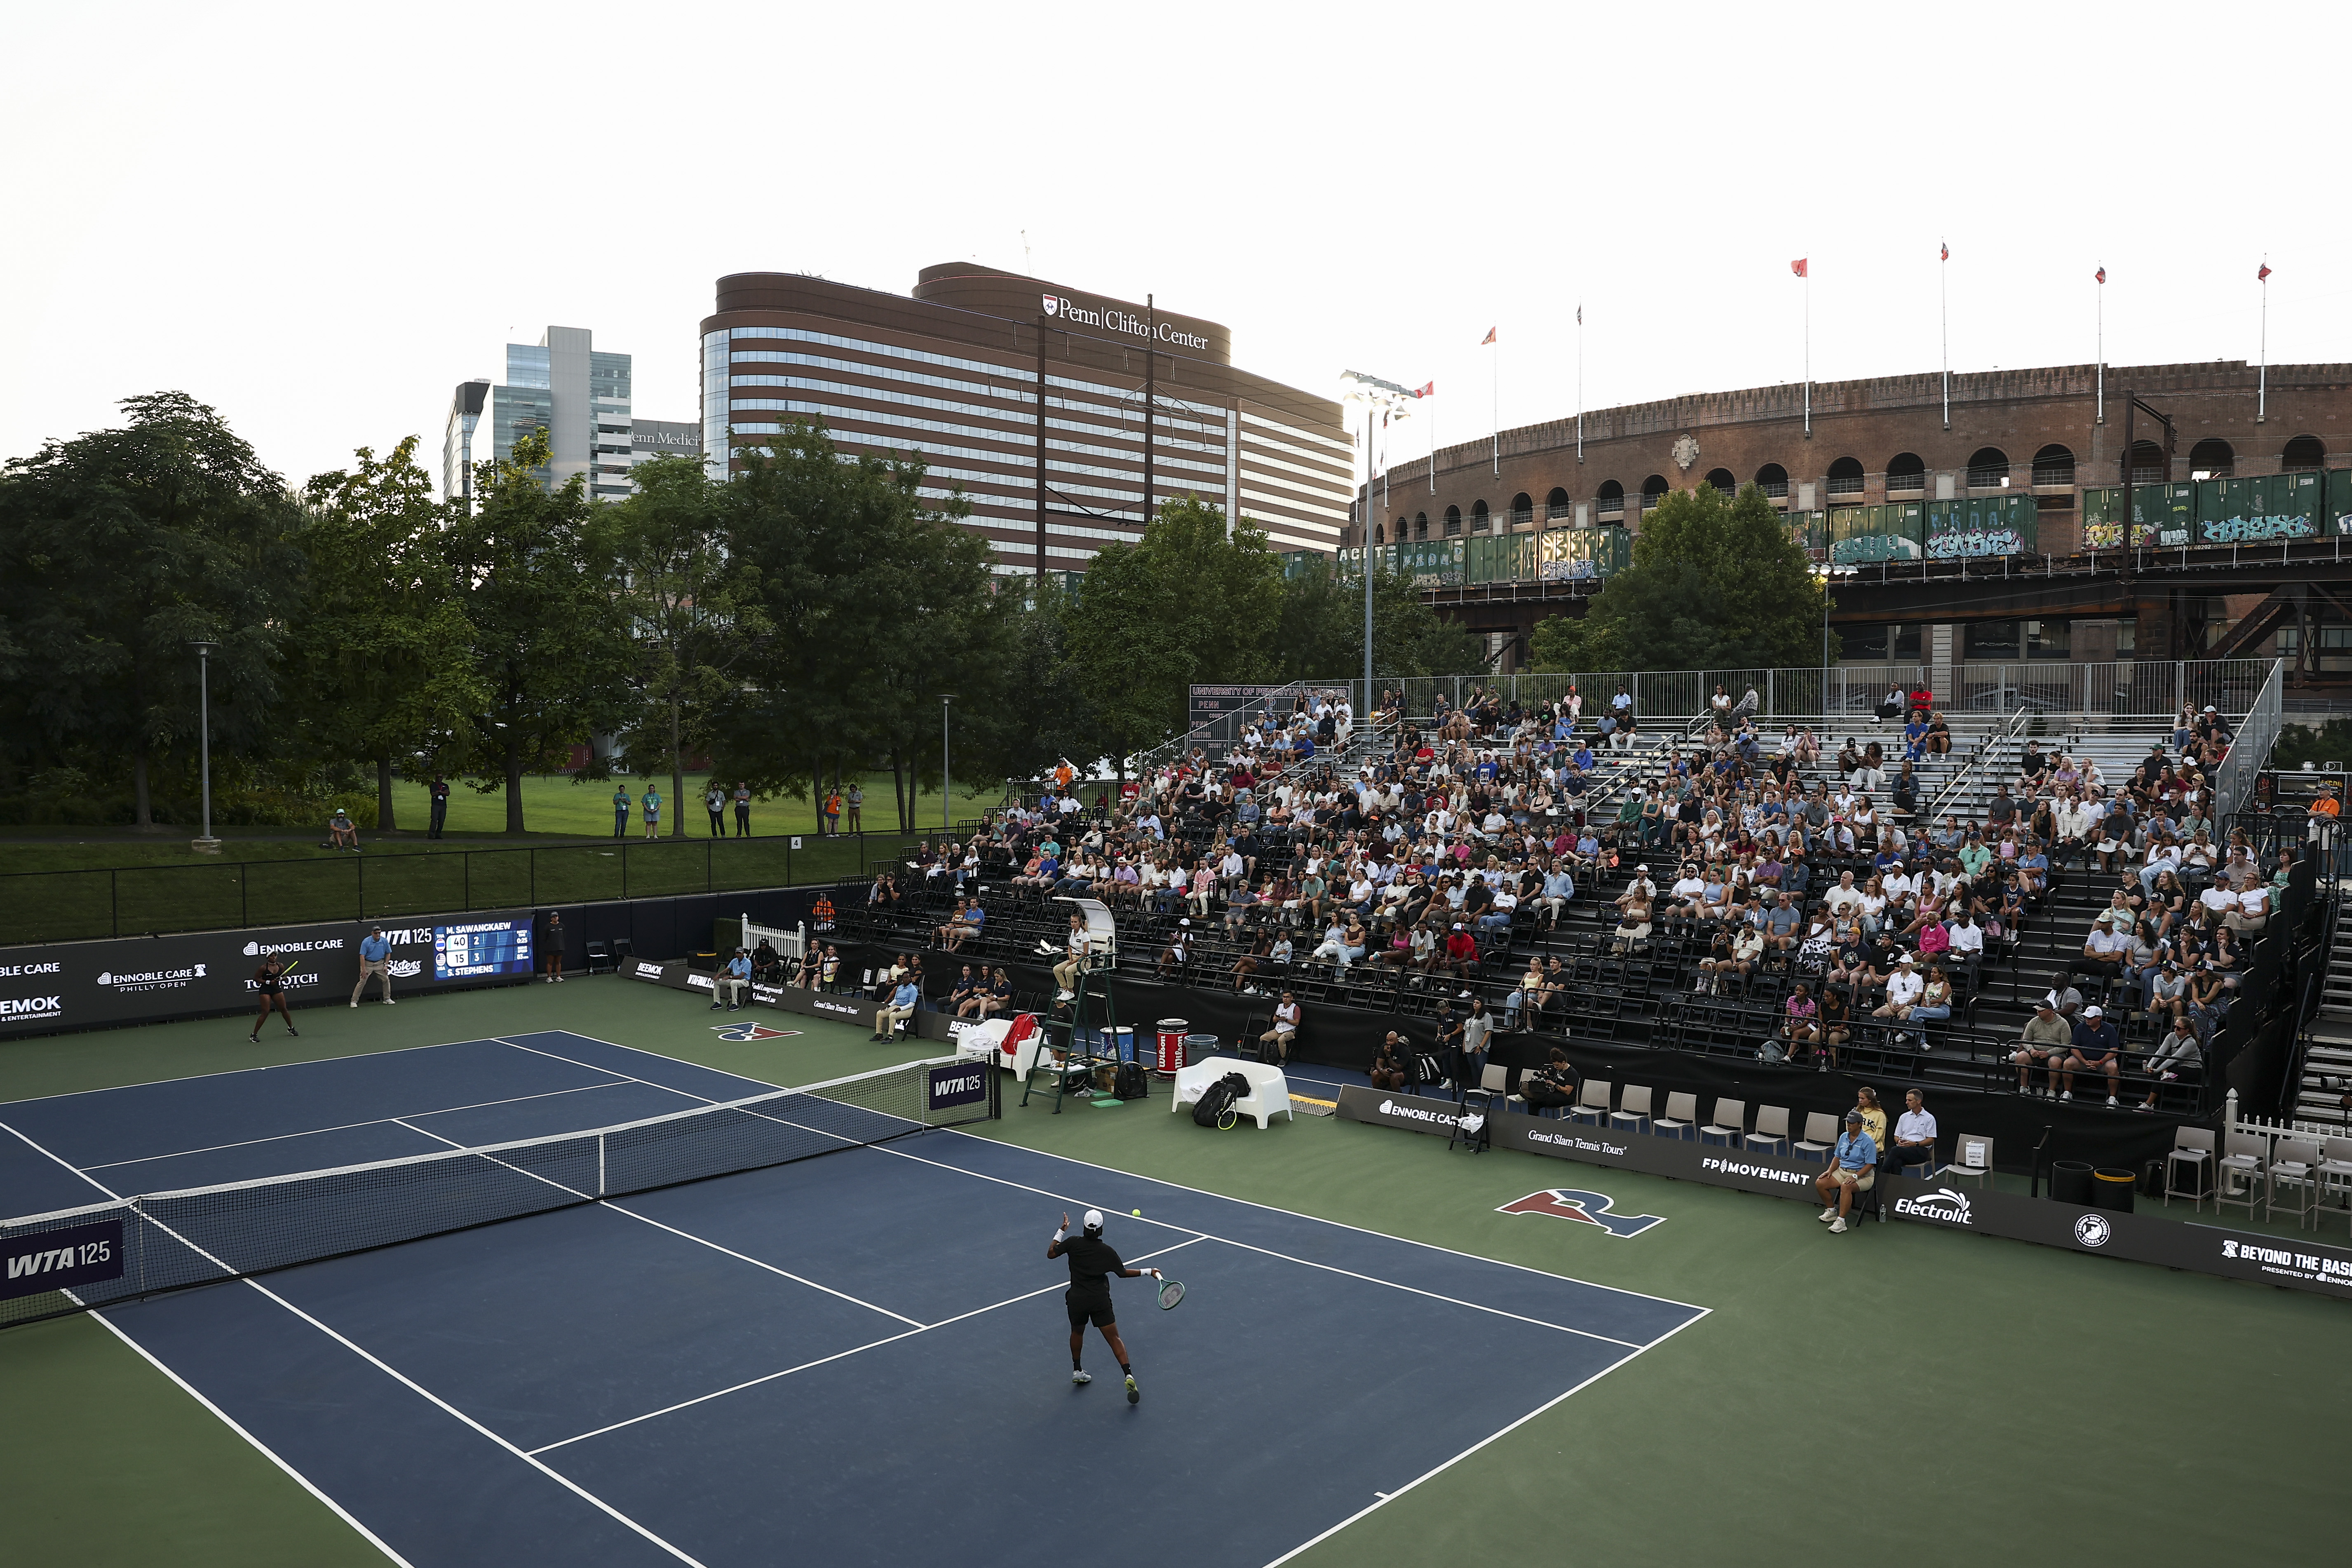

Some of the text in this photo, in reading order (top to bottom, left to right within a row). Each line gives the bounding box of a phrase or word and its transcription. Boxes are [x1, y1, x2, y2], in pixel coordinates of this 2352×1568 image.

[1058, 297, 1100, 326] Penn
[1159, 323, 1209, 350] Center
[657, 432, 701, 446] Medici
[412, 927, 432, 943] 125
[455, 922, 511, 934] SAWANGKAEW
[260, 939, 343, 955] ENNOBLE CARE
[454, 937, 465, 946] 40
[474, 936, 479, 945] 2
[455, 954, 464, 963] 15
[474, 953, 480, 962] 3
[24, 962, 61, 974] CARE
[455, 965, 494, 976] STEPHENS
[637, 962, 664, 975] BEEMOK
[113, 969, 193, 984] ENNOBLE CARE
[279, 973, 319, 986] OTCH
[120, 984, 155, 993] PHILLY
[0, 995, 61, 1014] EMOK
[814, 1000, 825, 1008] Grand
[825, 1002, 835, 1011] Slam
[835, 1004, 847, 1013] Tennis
[7, 1011, 62, 1021] ENTERTAINMENT
[935, 1075, 980, 1096] WTA 125
[1392, 1106, 1462, 1127] ENNOBLE CAR
[1528, 1130, 1553, 1143] Grand
[1553, 1134, 1573, 1147] Slam
[1575, 1138, 1601, 1152] Tennis
[1702, 1157, 1810, 1185] FP MOVEMENT
[1895, 1198, 1972, 1224] Electrolit
[8, 1240, 110, 1279] WTA 125
[2240, 1244, 2292, 1266] BEYOND
[2294, 1253, 2320, 1271] THE
[2262, 1266, 2303, 1277] PRESENTED
